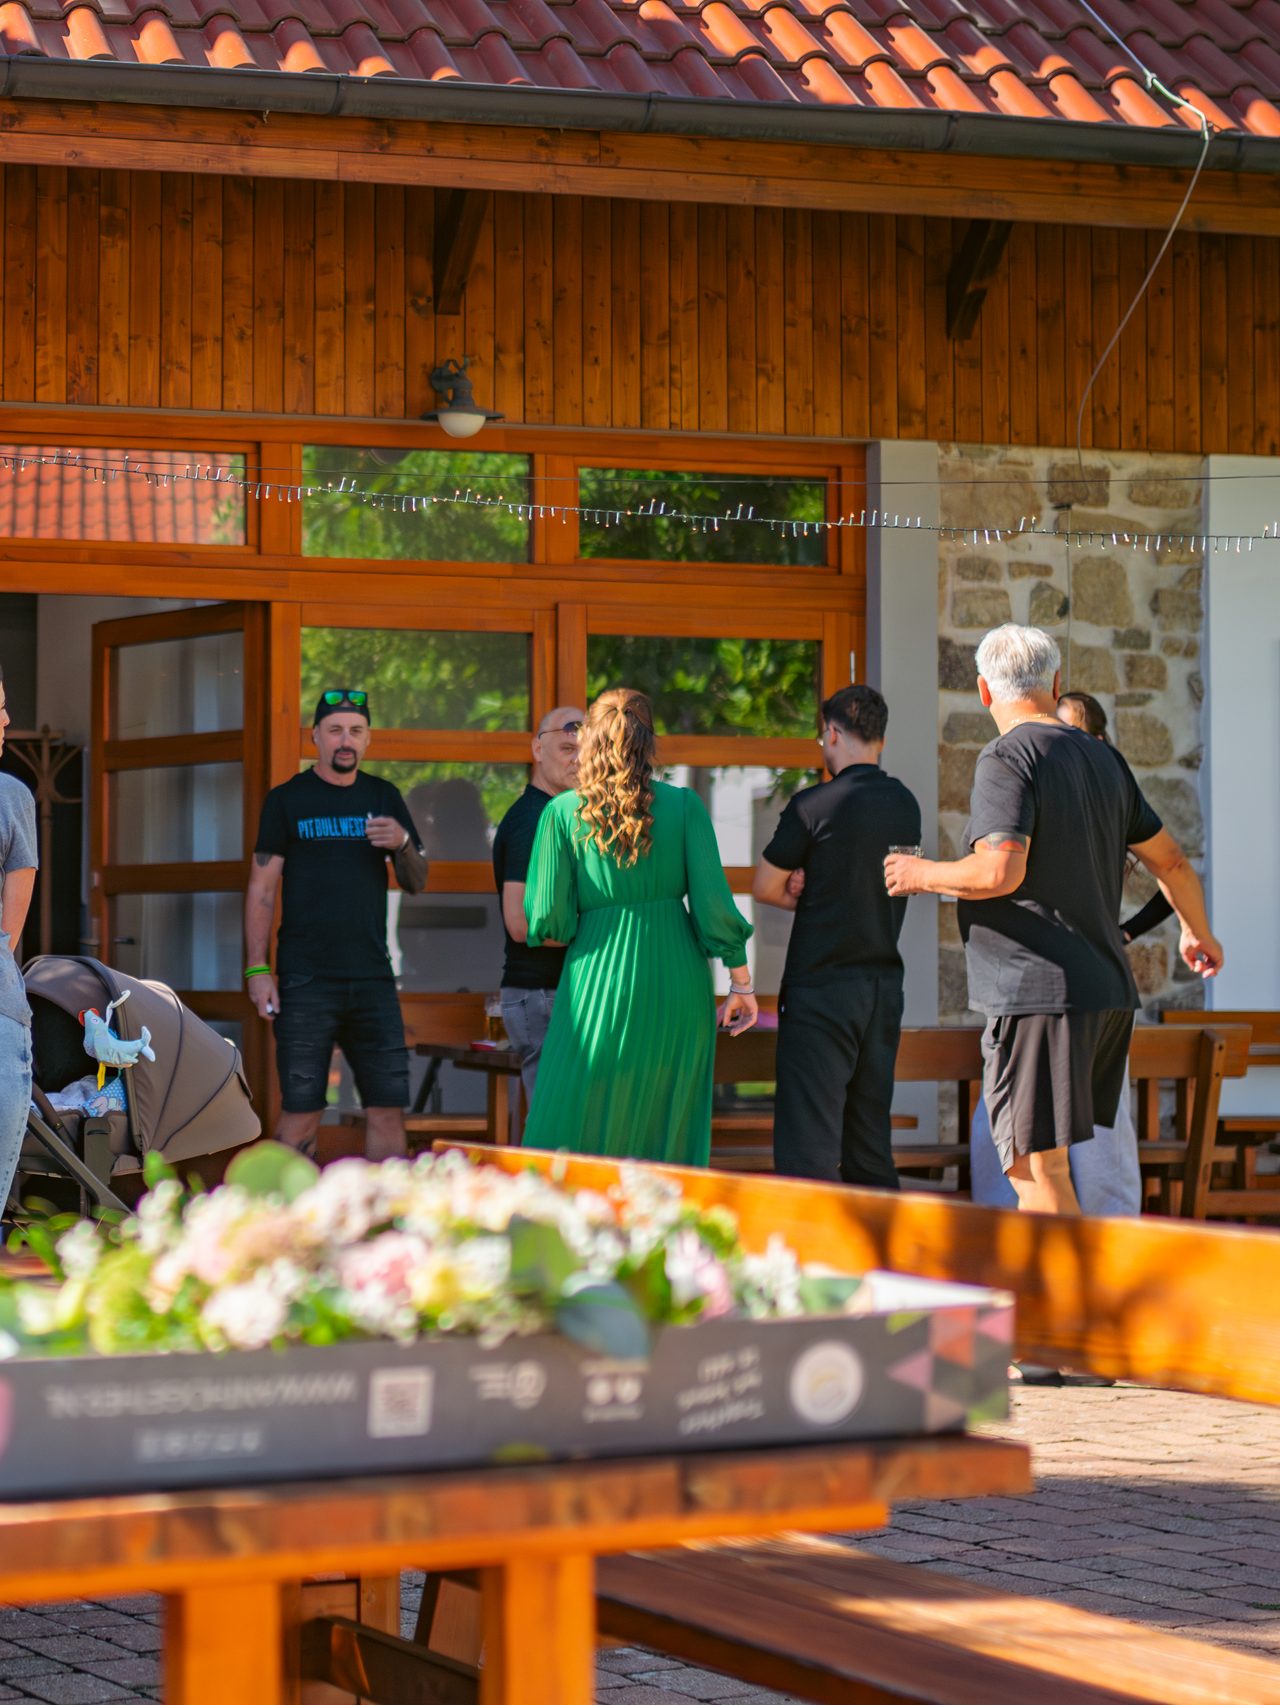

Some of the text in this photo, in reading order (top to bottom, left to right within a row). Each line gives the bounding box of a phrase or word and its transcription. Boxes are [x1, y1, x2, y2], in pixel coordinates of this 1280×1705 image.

[297, 819, 314, 839] PIT
[315, 817, 341, 836] BULL
[339, 817, 365, 836] WEST
